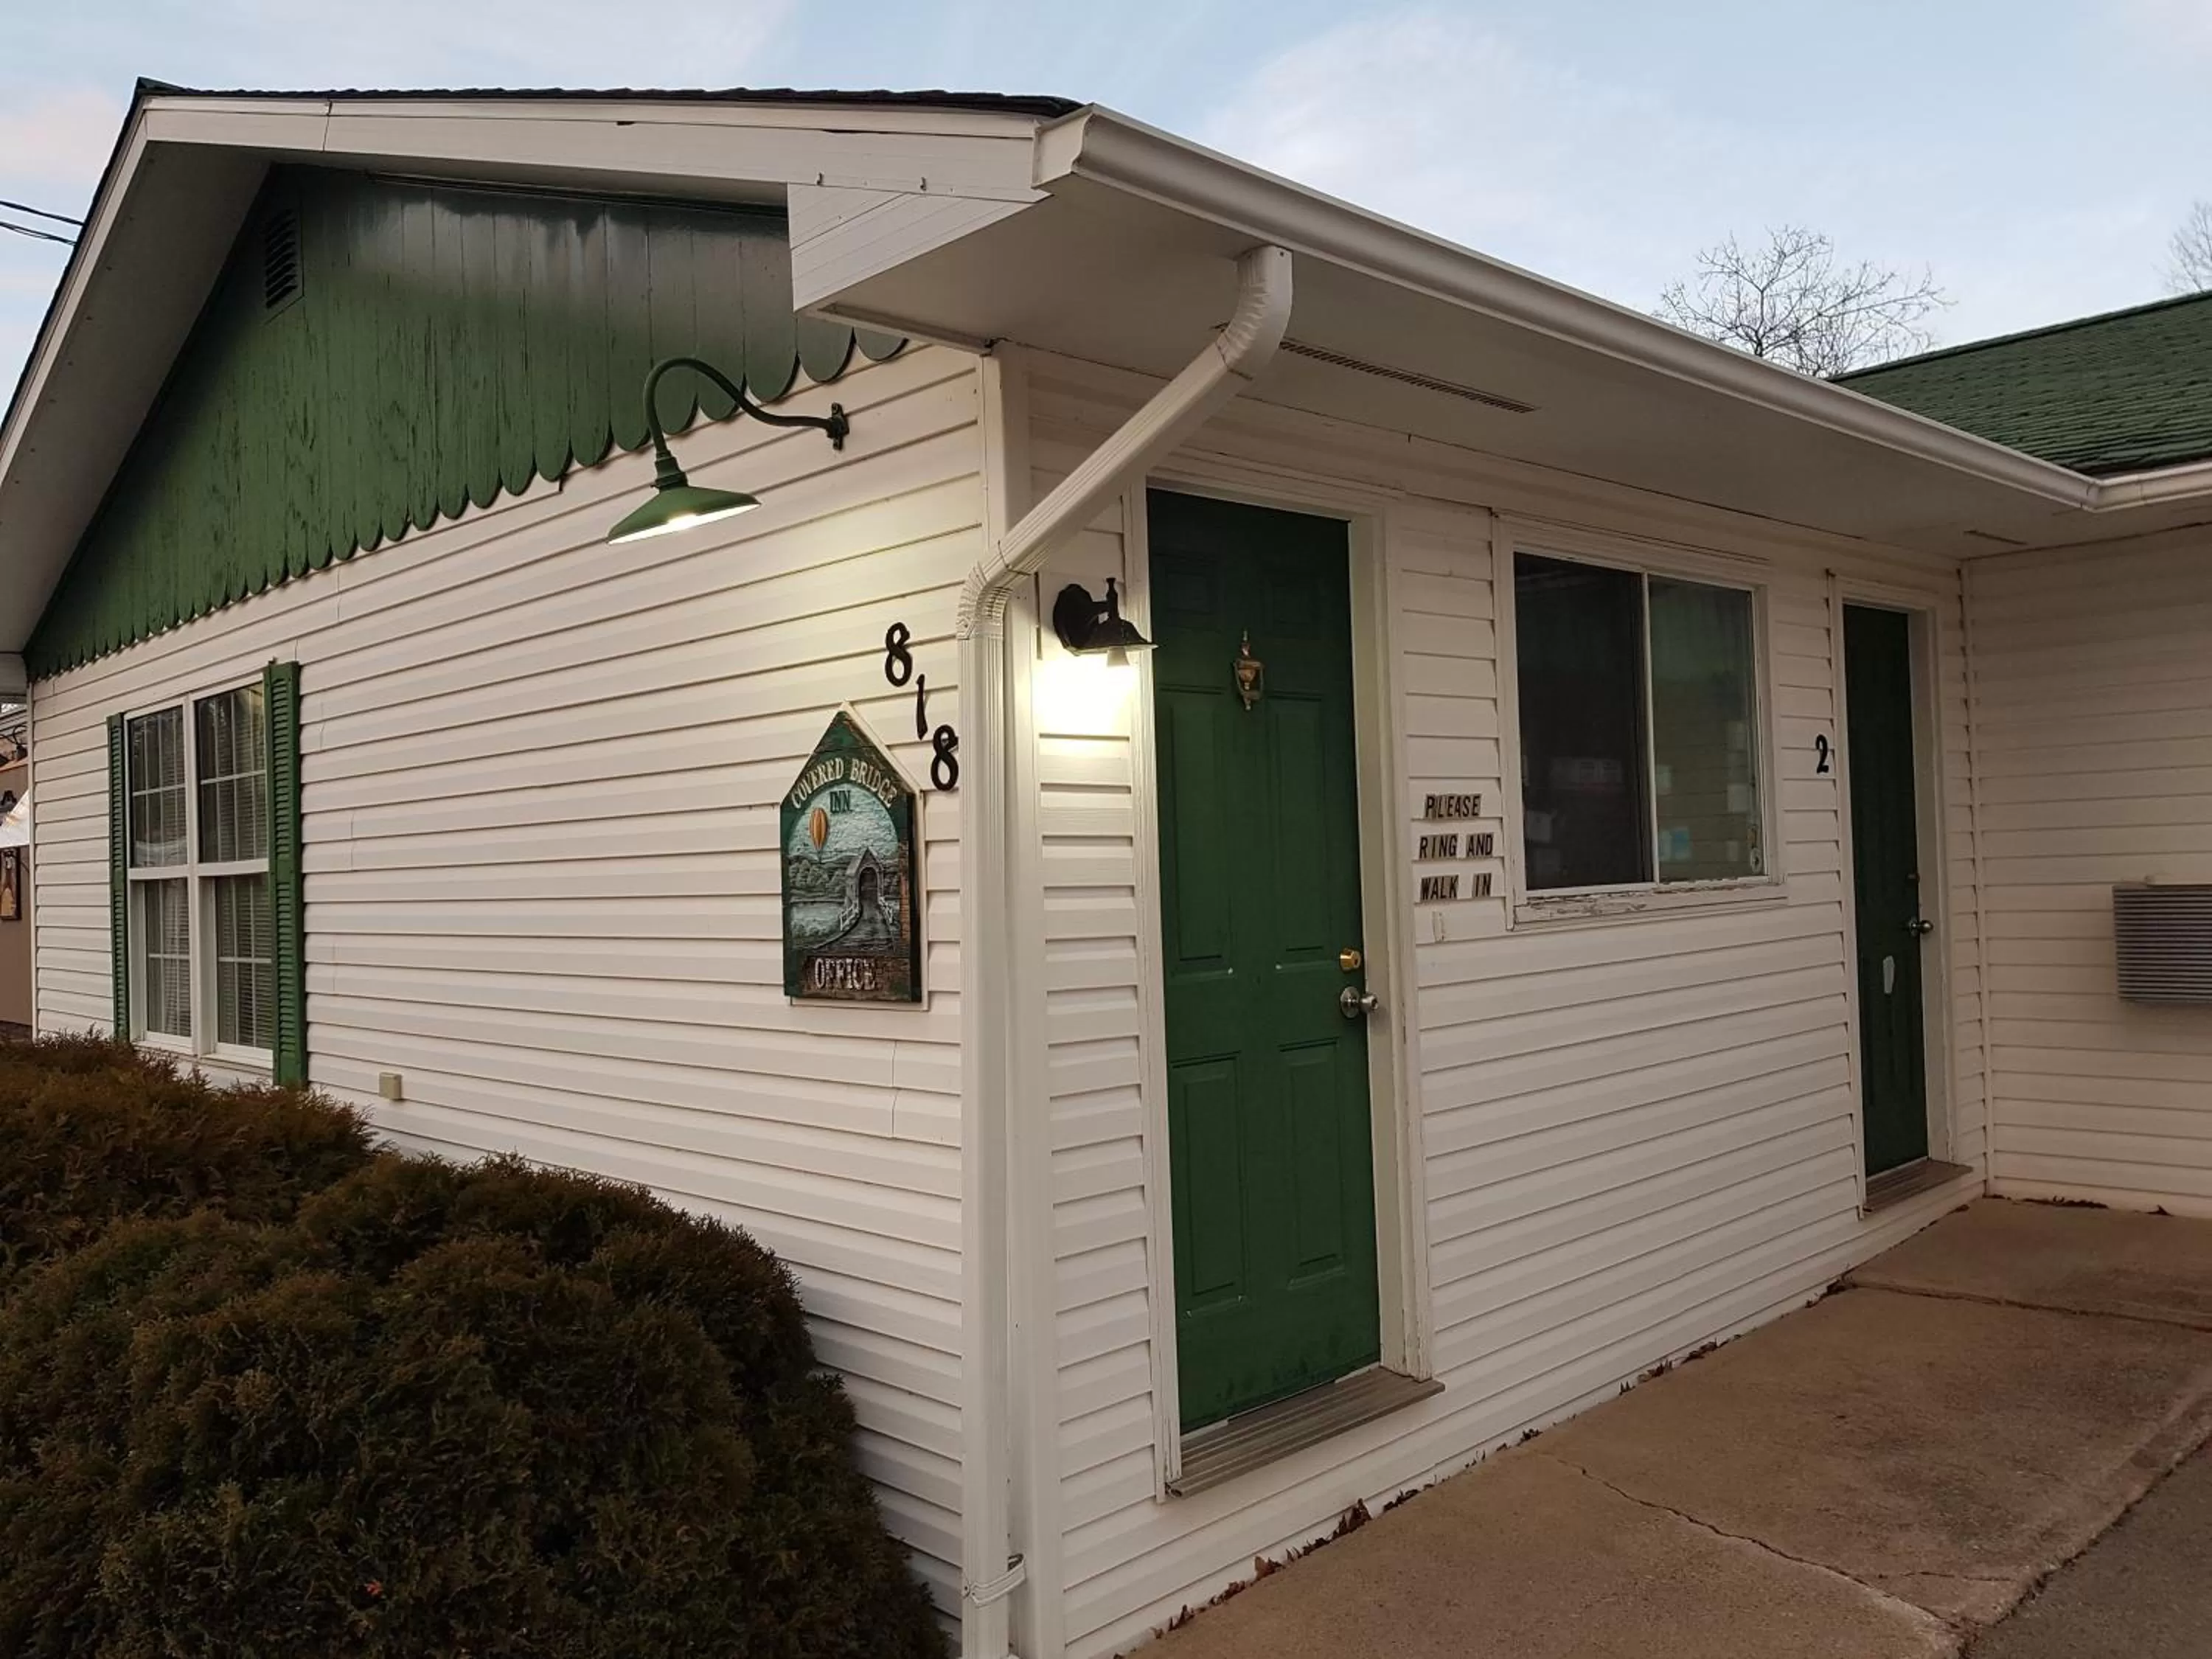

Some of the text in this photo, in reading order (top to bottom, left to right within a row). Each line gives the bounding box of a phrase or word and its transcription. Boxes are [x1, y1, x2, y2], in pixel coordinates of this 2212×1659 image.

[885, 622, 959, 791] 818
[1815, 734, 1829, 773] 2
[791, 757, 897, 809] COVERED BRIDGE
[830, 790, 852, 813] INN
[1425, 795, 1481, 818] PLEASE
[1419, 834, 1494, 859] RING AND
[1420, 874, 1492, 900] WALK IN
[815, 958, 876, 990] OFFICE
